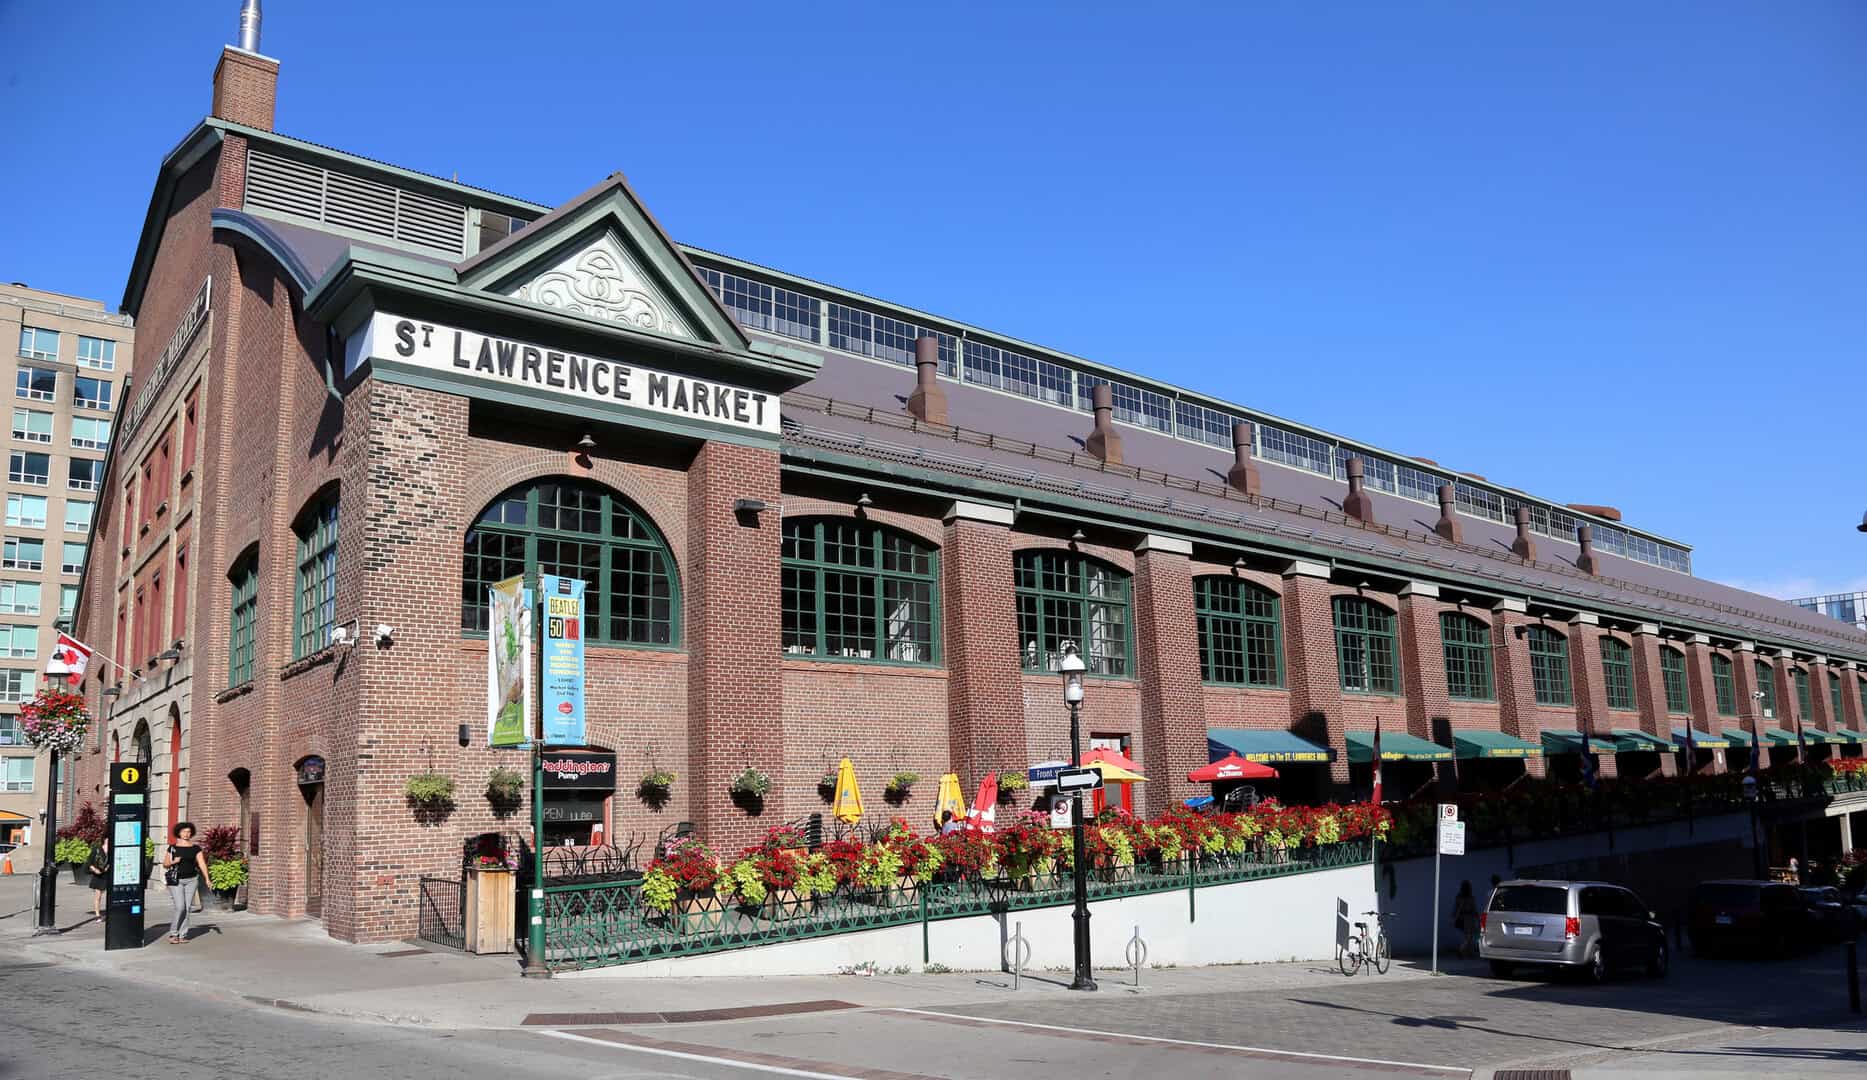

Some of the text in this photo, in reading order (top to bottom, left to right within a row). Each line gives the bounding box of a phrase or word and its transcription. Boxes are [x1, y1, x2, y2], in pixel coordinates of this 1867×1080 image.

[453, 331, 631, 400] LAWRENCE
[648, 372, 767, 425] MARKET
[550, 619, 562, 637] 50
[558, 771, 578, 781] Pump
[1036, 769, 1053, 779] Front
